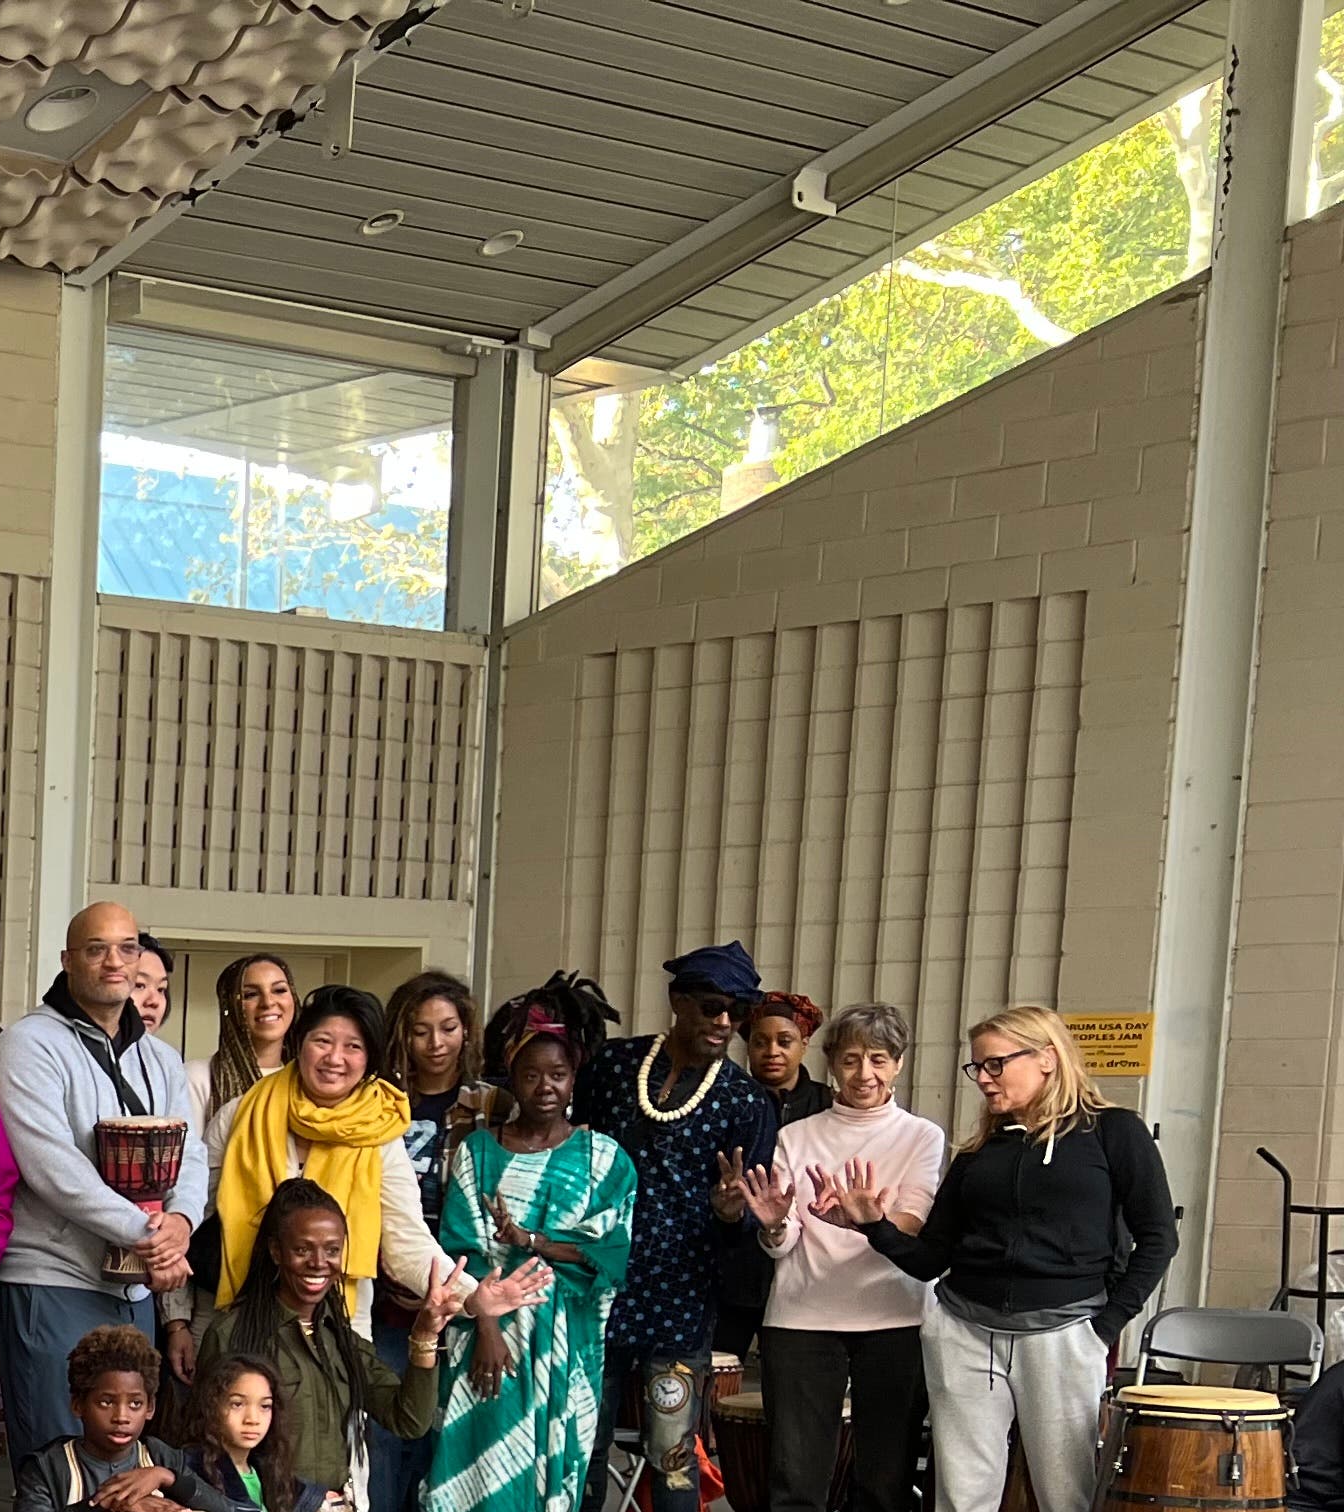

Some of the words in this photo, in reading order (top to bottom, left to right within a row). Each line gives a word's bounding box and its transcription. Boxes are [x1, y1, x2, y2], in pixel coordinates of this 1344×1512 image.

[1098, 1023, 1122, 1031] USA
[1125, 1022, 1149, 1030] DAY
[1072, 1033, 1116, 1041] EOPLES
[1118, 1033, 1143, 1041] JAM
